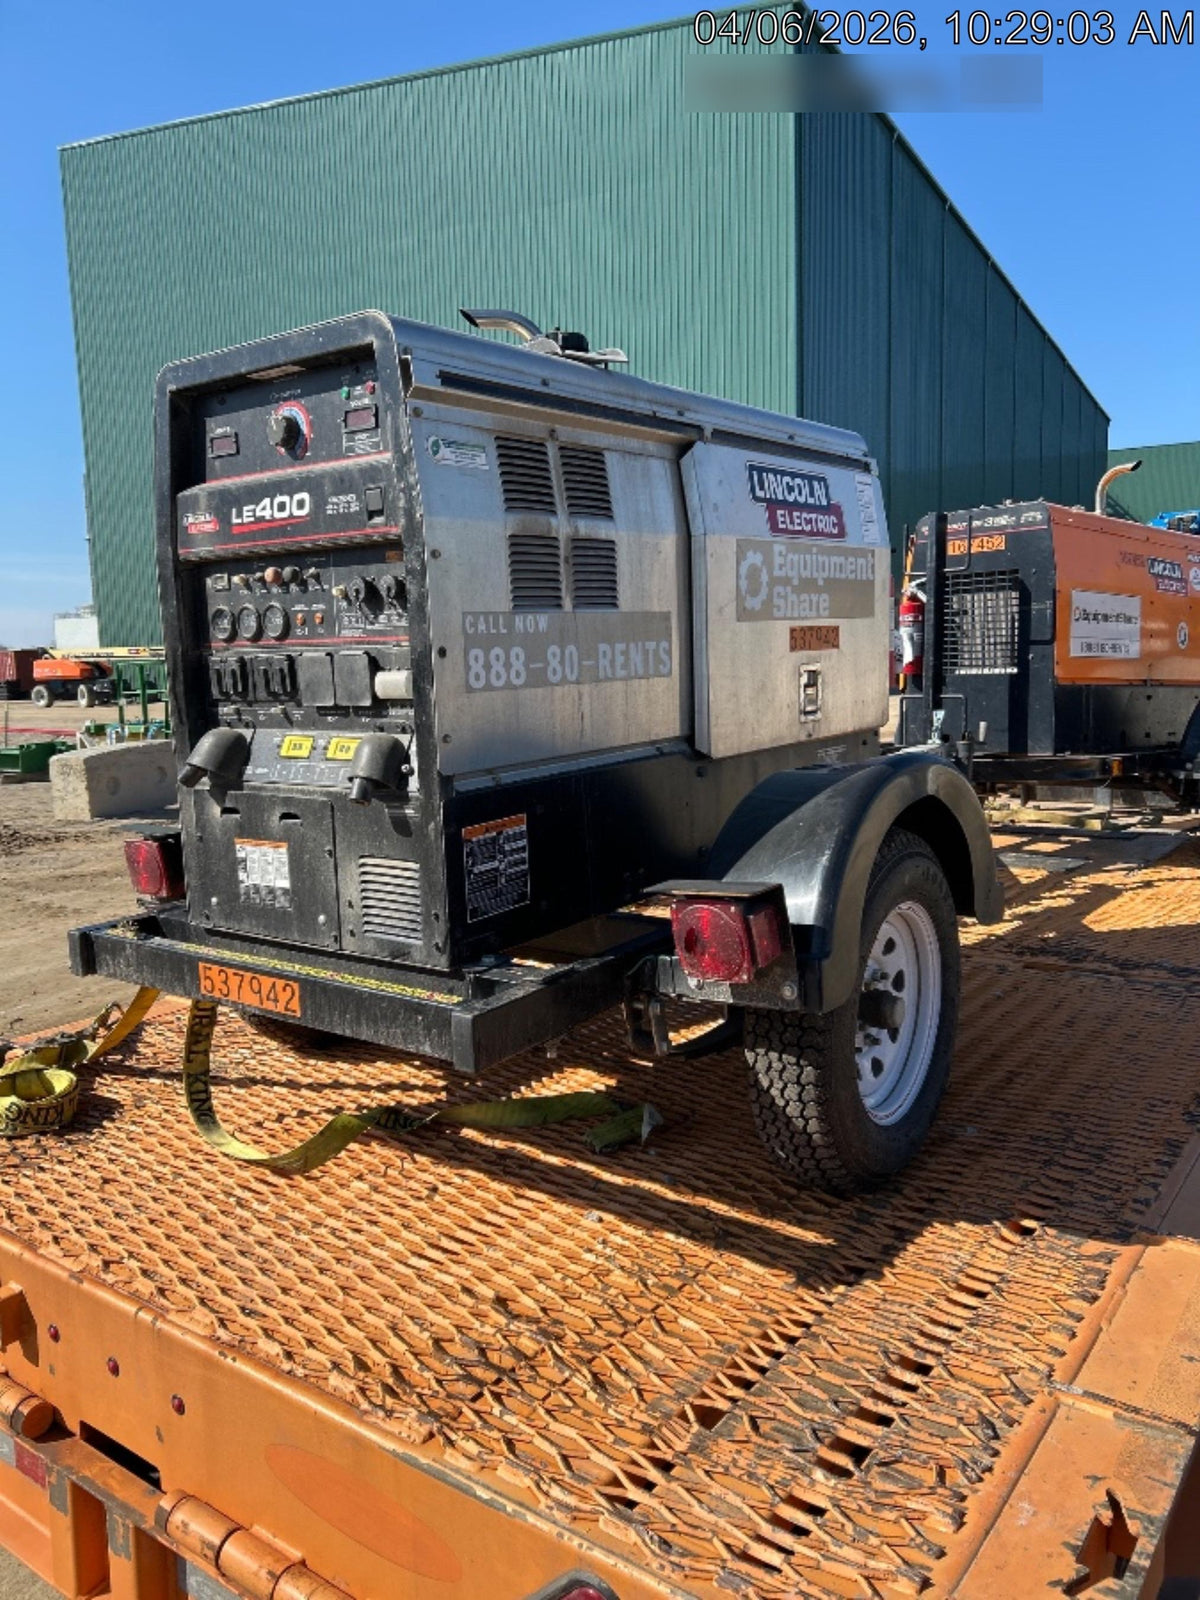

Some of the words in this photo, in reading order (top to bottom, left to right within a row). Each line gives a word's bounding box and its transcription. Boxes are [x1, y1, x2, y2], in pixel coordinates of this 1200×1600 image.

[752, 470, 829, 506] LINCOLN
[231, 491, 311, 524] LE400
[776, 508, 839, 535] ELECTRIC
[950, 535, 1005, 556] 16452
[772, 542, 875, 586] Equipment
[772, 585, 830, 618] Share
[464, 614, 508, 635] CALL
[513, 613, 550, 633] NOW
[467, 640, 671, 689] 888-80-RENTS
[201, 964, 298, 1015] 537942
[187, 1070, 217, 1126] KING
